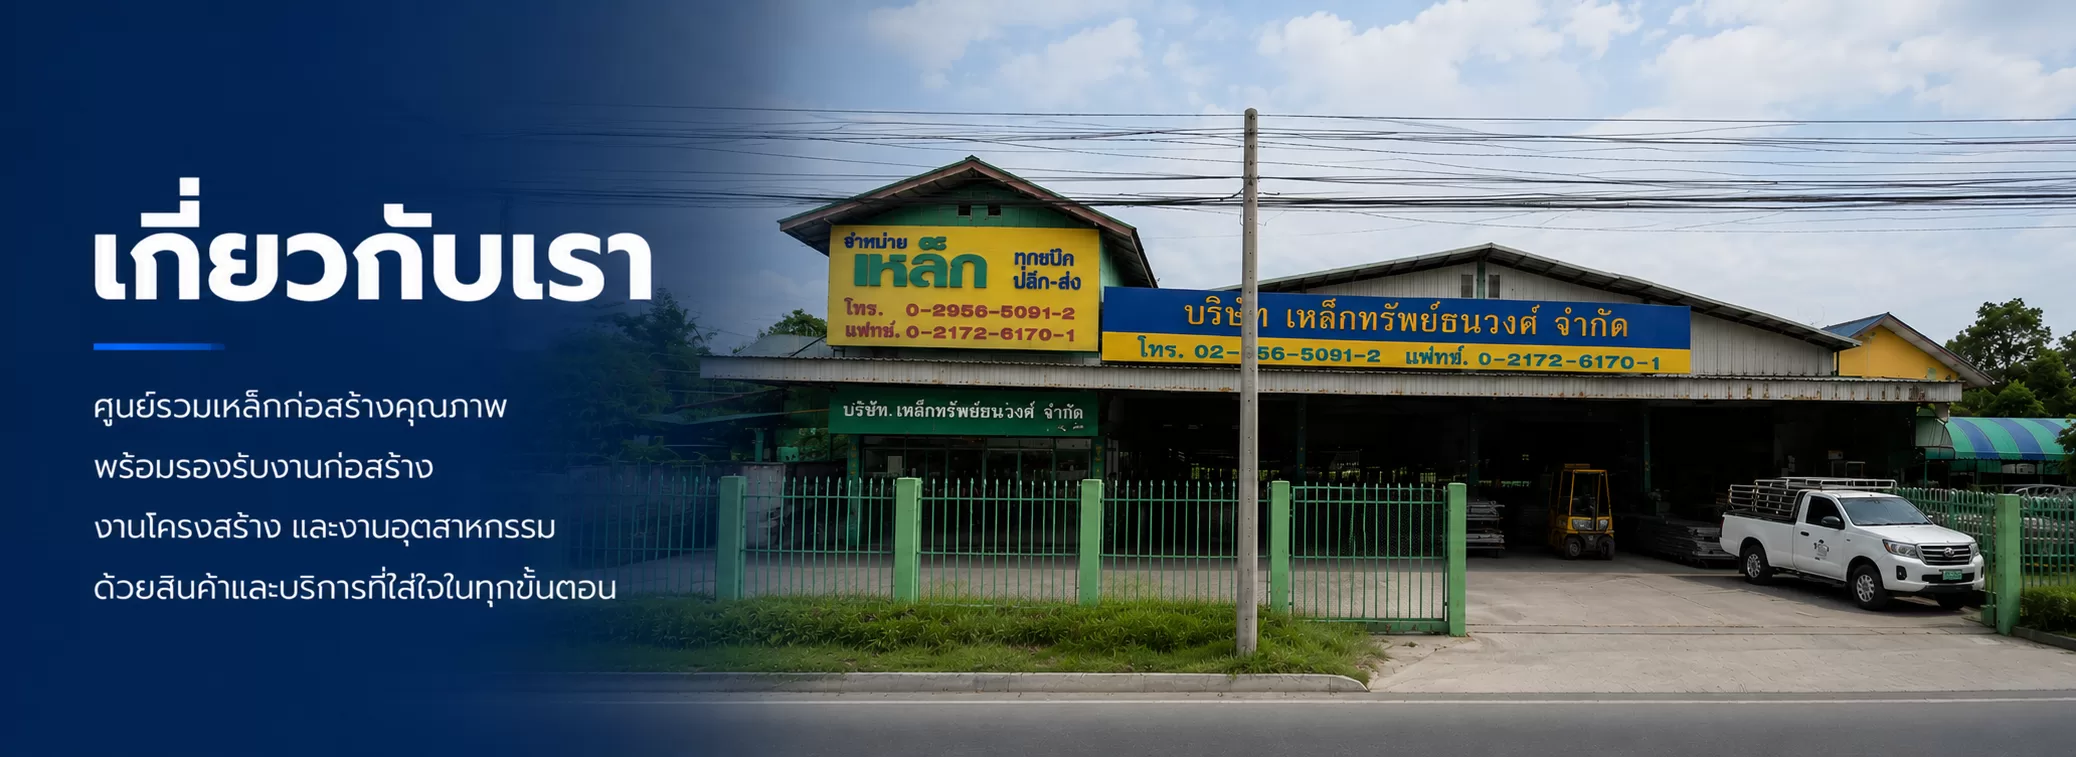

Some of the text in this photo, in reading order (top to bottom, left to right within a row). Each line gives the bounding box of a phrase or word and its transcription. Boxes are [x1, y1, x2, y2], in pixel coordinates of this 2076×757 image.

[854, 236, 988, 289] เหล็ก
[843, 296, 1075, 321] โทร. 0-2956-5091-2
[1287, 298, 1540, 335] เหล็กทรัพย์ธนวงศ์
[1555, 307, 1628, 337] จำกัด
[905, 325, 1075, 342] 0-2172-6170-1
[1137, 334, 1184, 359] โทร.
[1194, 344, 1381, 363] 02-56-5091-2
[1478, 353, 1660, 371] 0-2172-6170-1
[1043, 402, 1083, 420] จำกัด
